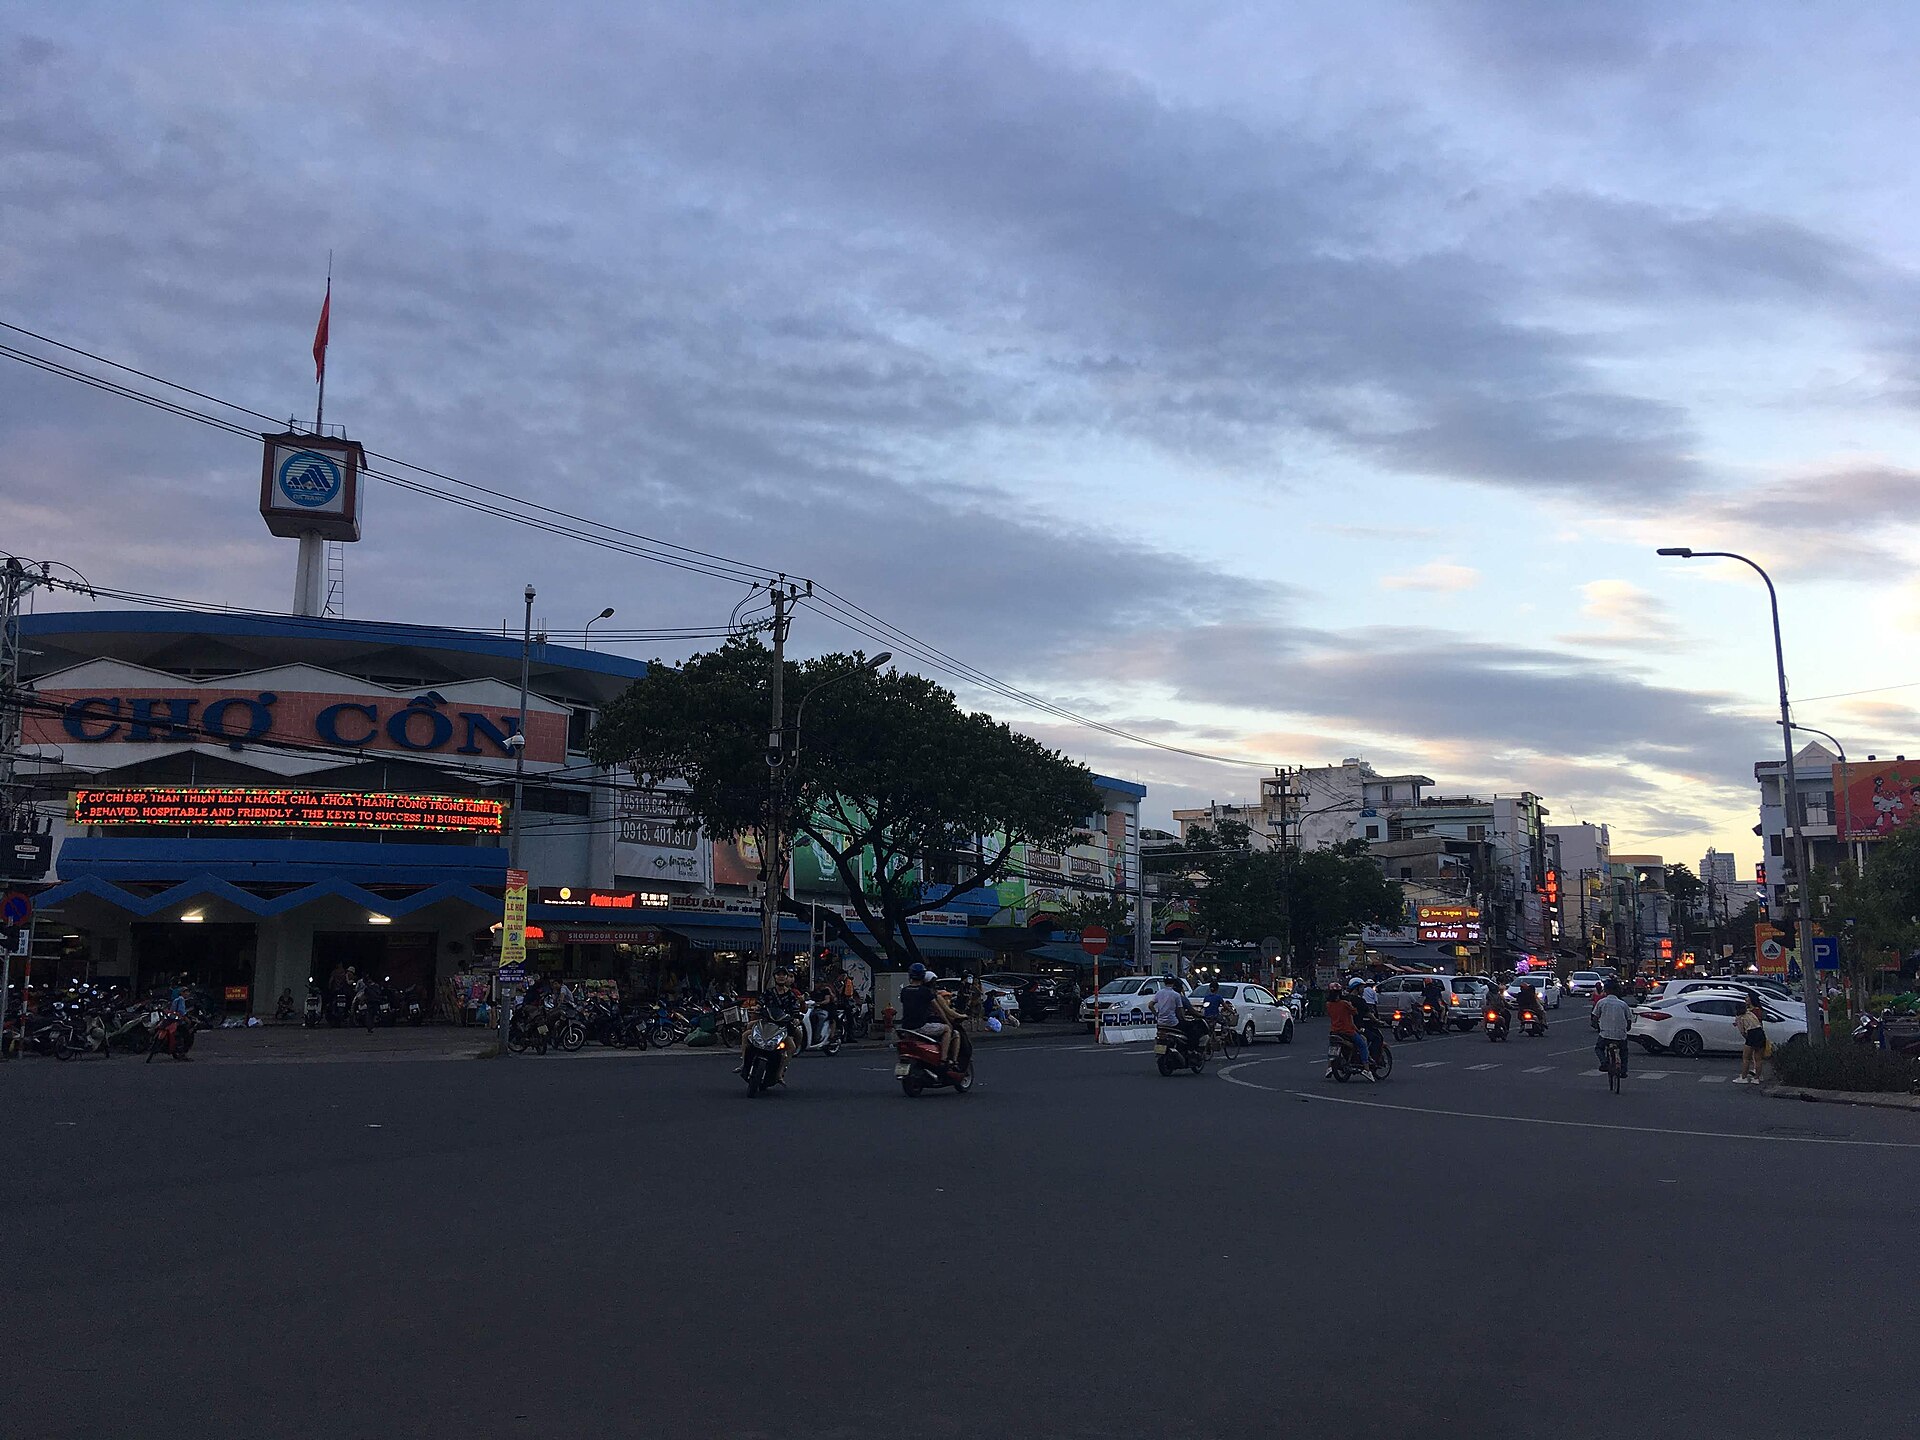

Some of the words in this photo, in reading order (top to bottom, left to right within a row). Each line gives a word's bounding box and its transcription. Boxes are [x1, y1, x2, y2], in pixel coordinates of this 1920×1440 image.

[63, 692, 277, 752] CHỢ
[316, 690, 520, 757] CỒN
[143, 807, 208, 817] HOSPITABLE
[209, 807, 235, 817] AND
[237, 807, 294, 818] FRIENDLY
[301, 809, 325, 819] THE
[326, 810, 356, 820] KEYS
[357, 811, 373, 820] TO
[375, 812, 421, 822] SUCCESS
[423, 814, 436, 823] IN
[1814, 944, 1830, 962] P
